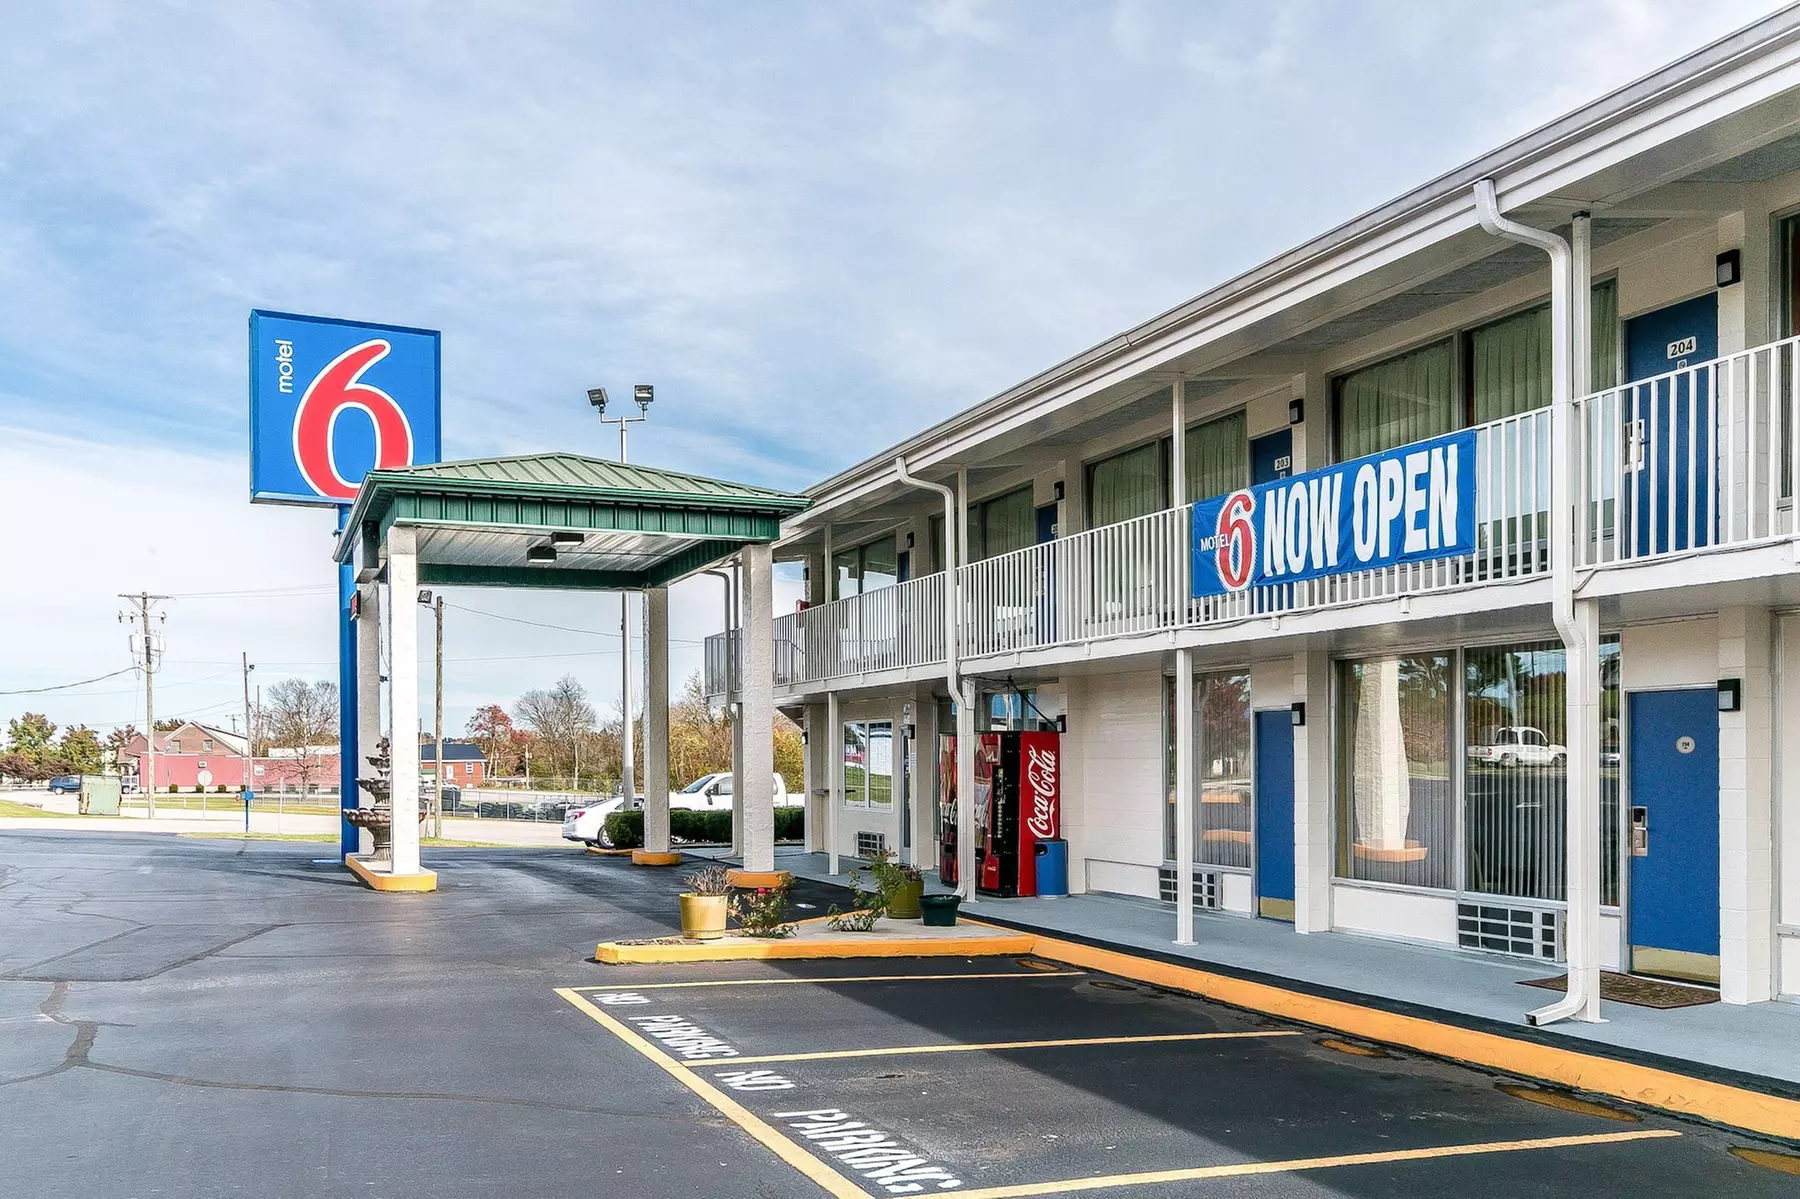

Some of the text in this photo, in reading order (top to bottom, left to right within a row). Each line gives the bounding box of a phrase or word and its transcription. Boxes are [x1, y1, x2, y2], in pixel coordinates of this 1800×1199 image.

[1670, 339, 1693, 356] 204
[275, 338, 414, 499] motel 6
[1200, 490, 1256, 591] MOTEL 6
[1263, 444, 1458, 577] NOW OPEN
[1028, 744, 1056, 839] Coca-Cola
[592, 992, 651, 1005] NO
[628, 1014, 740, 1059] PARKING
[714, 1070, 796, 1091] NO
[773, 1108, 961, 1193] PARKING
